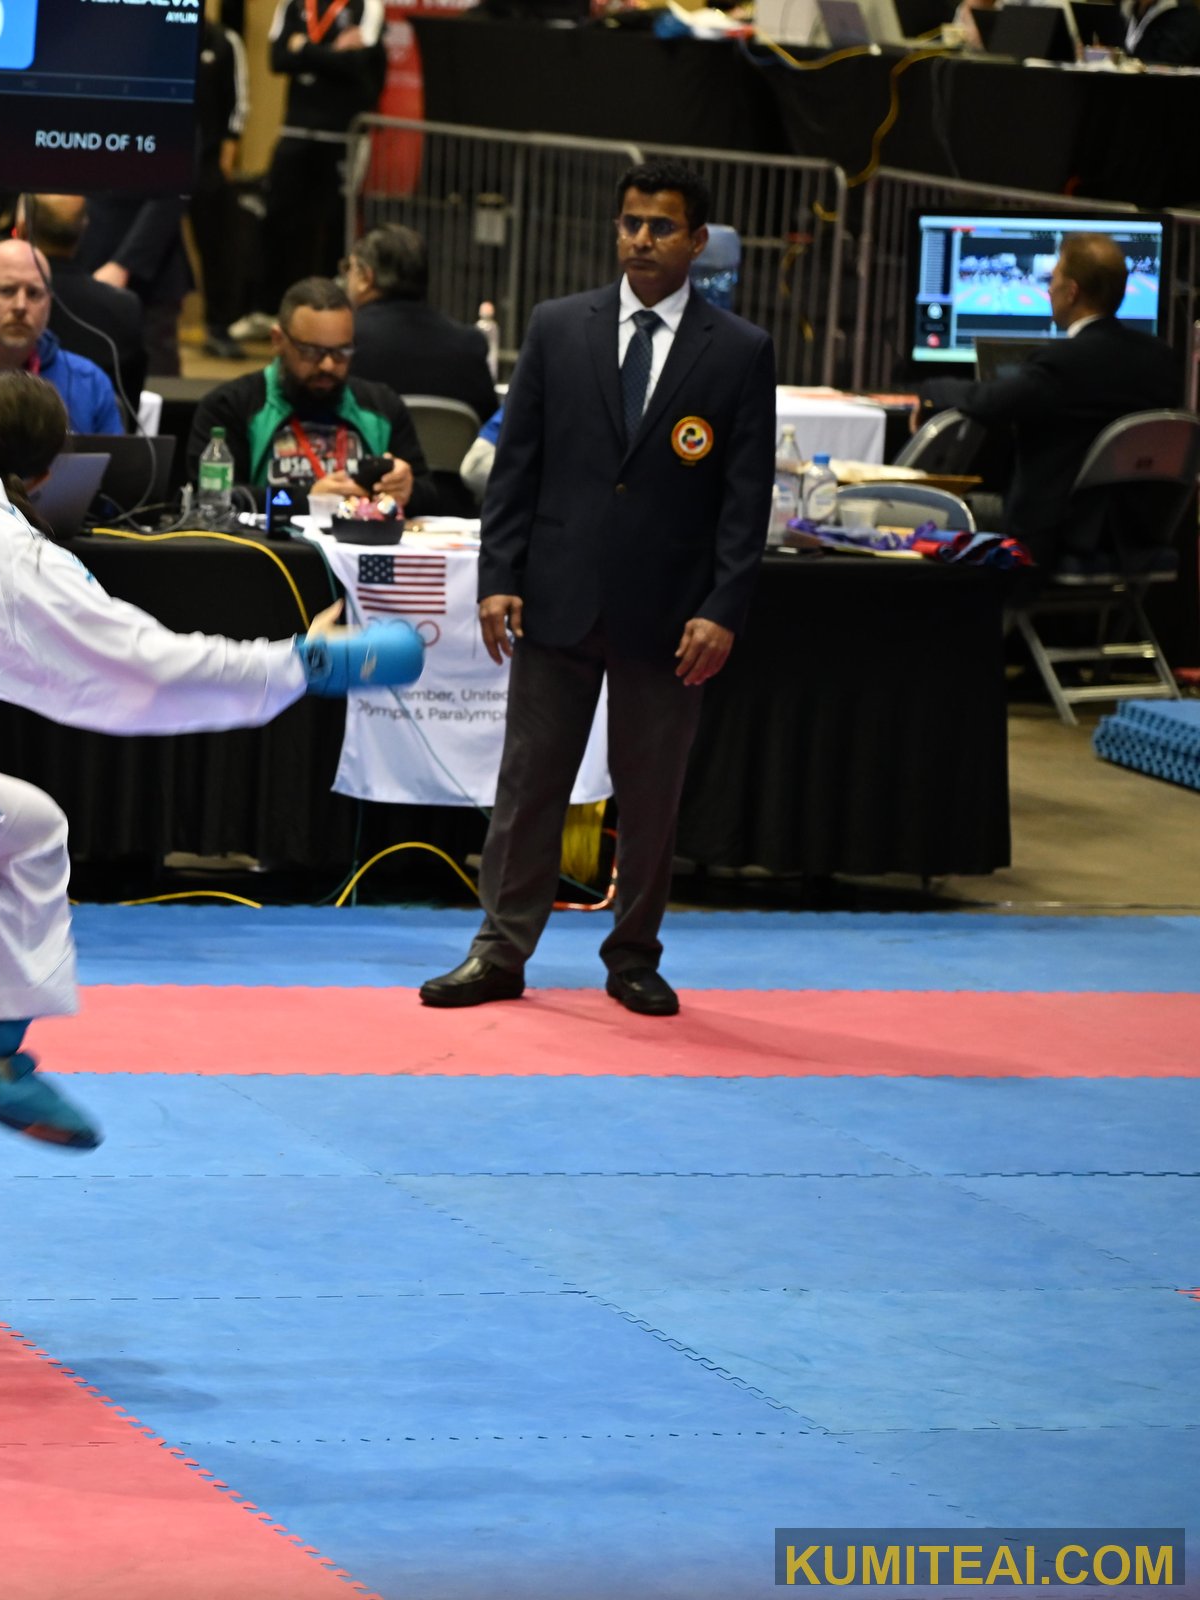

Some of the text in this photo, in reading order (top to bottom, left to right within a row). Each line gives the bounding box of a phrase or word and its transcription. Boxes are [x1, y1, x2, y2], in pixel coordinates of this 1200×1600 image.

[35, 130, 156, 153] ROUND OF 16
[402, 688, 456, 703] ember,
